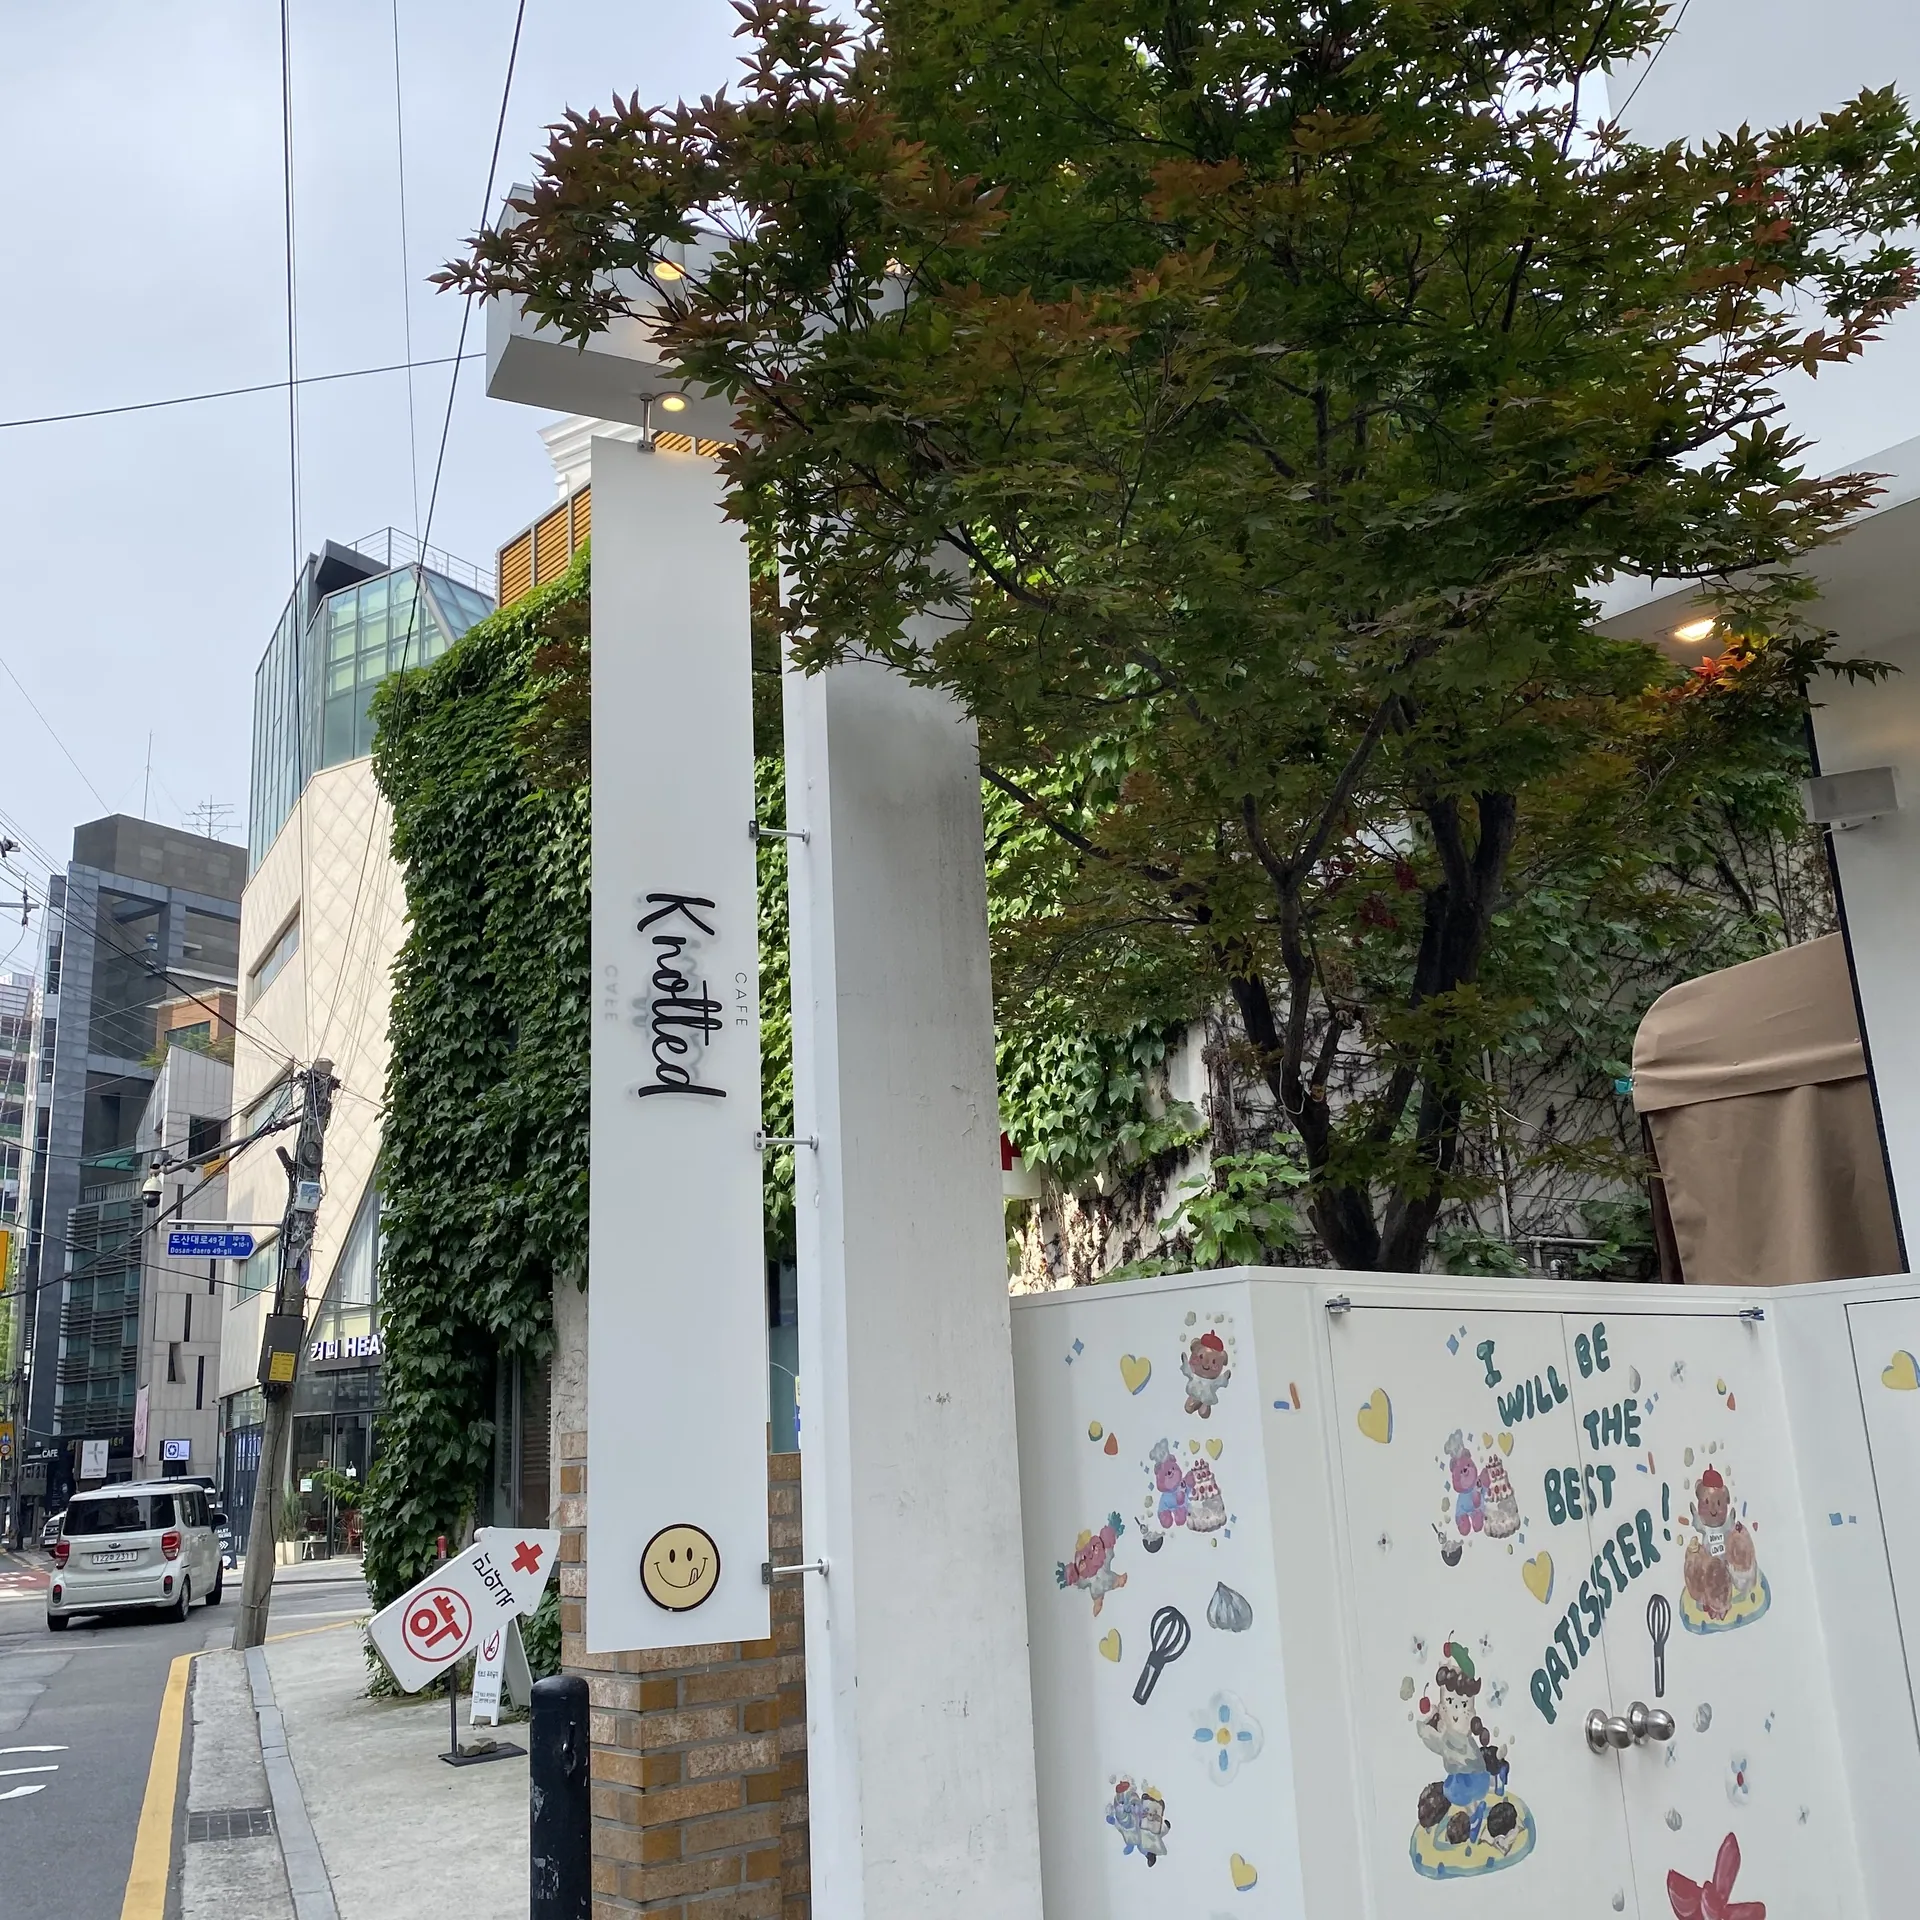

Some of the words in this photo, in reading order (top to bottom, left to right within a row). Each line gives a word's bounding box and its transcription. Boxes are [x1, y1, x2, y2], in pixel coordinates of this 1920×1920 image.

[636, 893, 727, 1098] Knotted
[735, 971, 748, 1027] CAFE
[170, 1246, 211, 1254] Dosan-daero
[212, 1247, 232, 1256] 49-gil
[171, 1234, 226, 1247] 도산대로49길
[310, 1339, 339, 1362] 커피
[344, 1333, 381, 1358] HEA
[1476, 1339, 1502, 1388] I
[1497, 1365, 1569, 1427] WILL
[1574, 1321, 1611, 1379] BE
[1583, 1398, 1642, 1450] THE
[42, 1448, 59, 1459] CAFE
[1544, 1464, 1617, 1526] BEST
[472, 1552, 516, 1608] 민약국
[1530, 1482, 1672, 1725] PATISSIER!
[409, 1594, 464, 1649] 약
